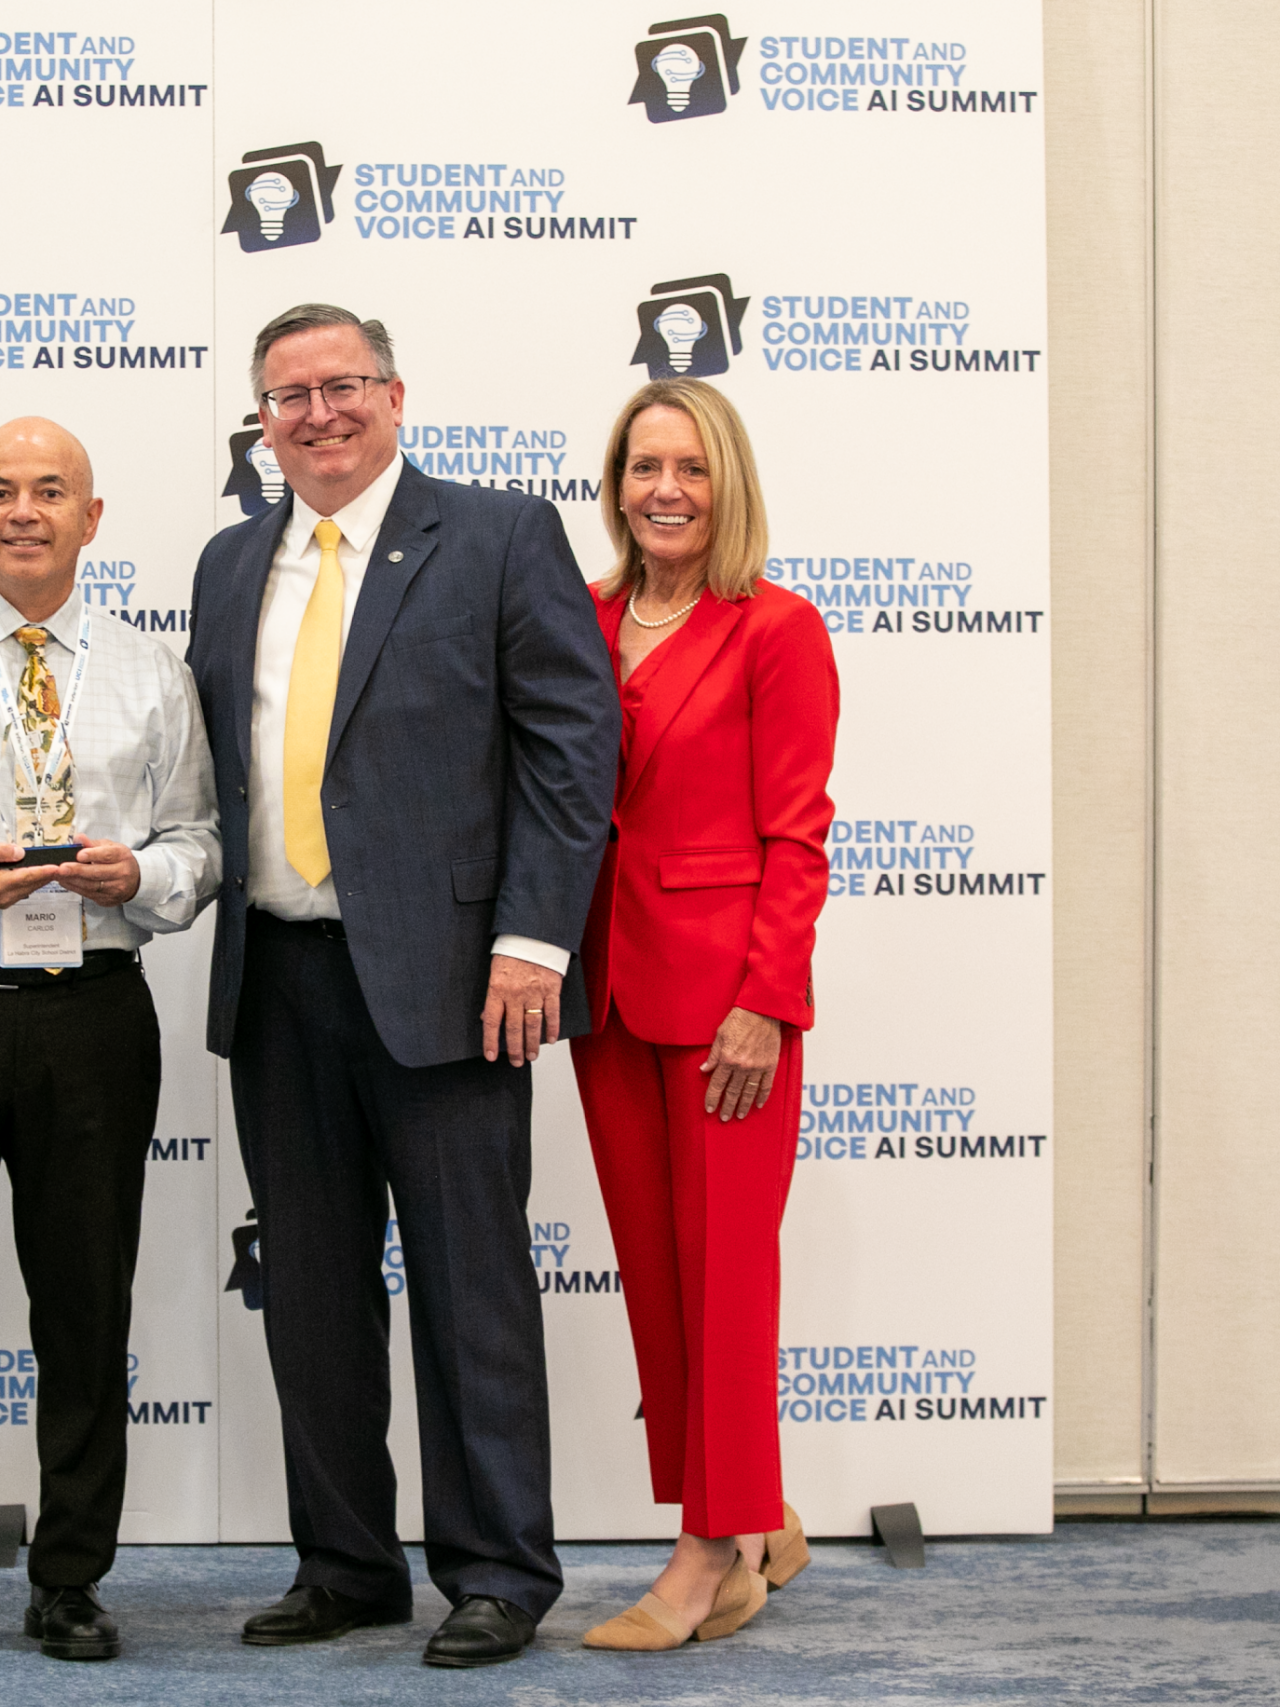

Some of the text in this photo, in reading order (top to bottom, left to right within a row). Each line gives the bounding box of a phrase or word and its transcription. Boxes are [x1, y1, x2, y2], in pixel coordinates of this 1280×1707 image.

[80, 37, 134, 54] AND
[760, 37, 966, 60] STUDENT AND
[760, 62, 965, 86] COMMUNITY
[32, 85, 63, 106] AI
[73, 84, 208, 107] SUMMIT
[760, 88, 1037, 113] VOICE AI SUMMIT
[355, 164, 564, 186] STUDENT AND
[355, 190, 564, 213] COMMUNITY
[355, 216, 637, 239] VOICE AI SUMMIT
[81, 298, 135, 316] AND
[763, 296, 969, 319] STUDENT AND
[763, 322, 969, 345] COMMUNITY
[32, 346, 63, 368] AI
[73, 346, 208, 369] SUMMIT
[763, 348, 1041, 372] VOICE AI SUMMIT
[398, 426, 566, 449] UDENT AND
[407, 452, 566, 475] MMUNITY
[506, 479, 601, 501] SUMM
[81, 561, 135, 579] AND
[766, 558, 972, 580] STUDENT AND
[791, 584, 972, 607] OMMUNITY
[120, 610, 188, 632] MMI
[872, 611, 902, 633] AI
[912, 611, 1044, 633] SUMMIT
[832, 821, 974, 843] DENT AND
[874, 874, 904, 896] AI
[914, 873, 1046, 896] SUMMIT
[25, 913, 56, 922] MARIO
[803, 1084, 975, 1107] UDENT AND
[800, 1110, 975, 1134] OMMUNITY
[152, 1138, 211, 1161] MIT
[797, 1135, 1047, 1160] OICE AI SUMMIT
[534, 1223, 570, 1241] ND
[922, 1350, 975, 1368] AND
[128, 1401, 212, 1424] MMIT
[875, 1399, 905, 1421] AI
[915, 1396, 1047, 1420] SUMMIT
